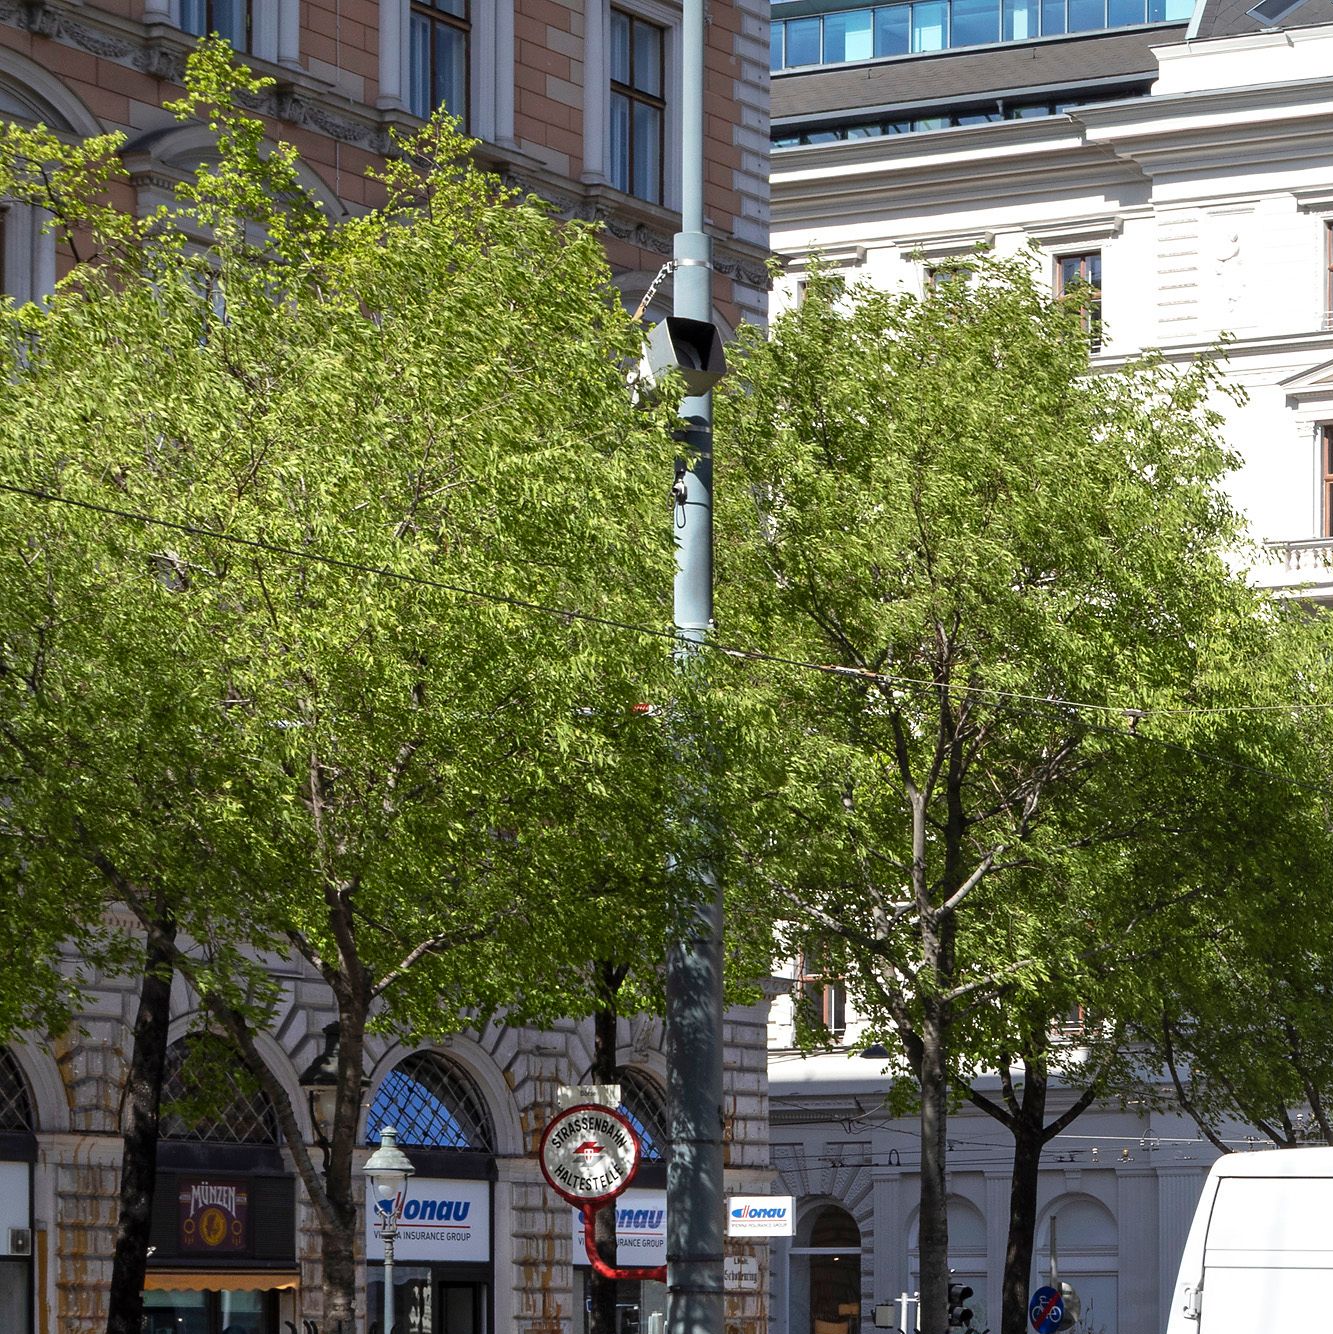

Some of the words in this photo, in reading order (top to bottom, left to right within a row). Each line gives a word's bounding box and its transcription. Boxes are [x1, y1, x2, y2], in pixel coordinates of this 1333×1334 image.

[552, 1117, 628, 1150] STRASSENBAHN
[554, 1163, 624, 1191] HALTESTELLE
[189, 1181, 237, 1218] MÜNZEN
[731, 1205, 787, 1219] donau
[373, 1231, 402, 1240] VIA
[403, 1231, 445, 1241] INSURANCE
[446, 1232, 472, 1241] GROUP
[642, 1239, 664, 1248] GROUP
